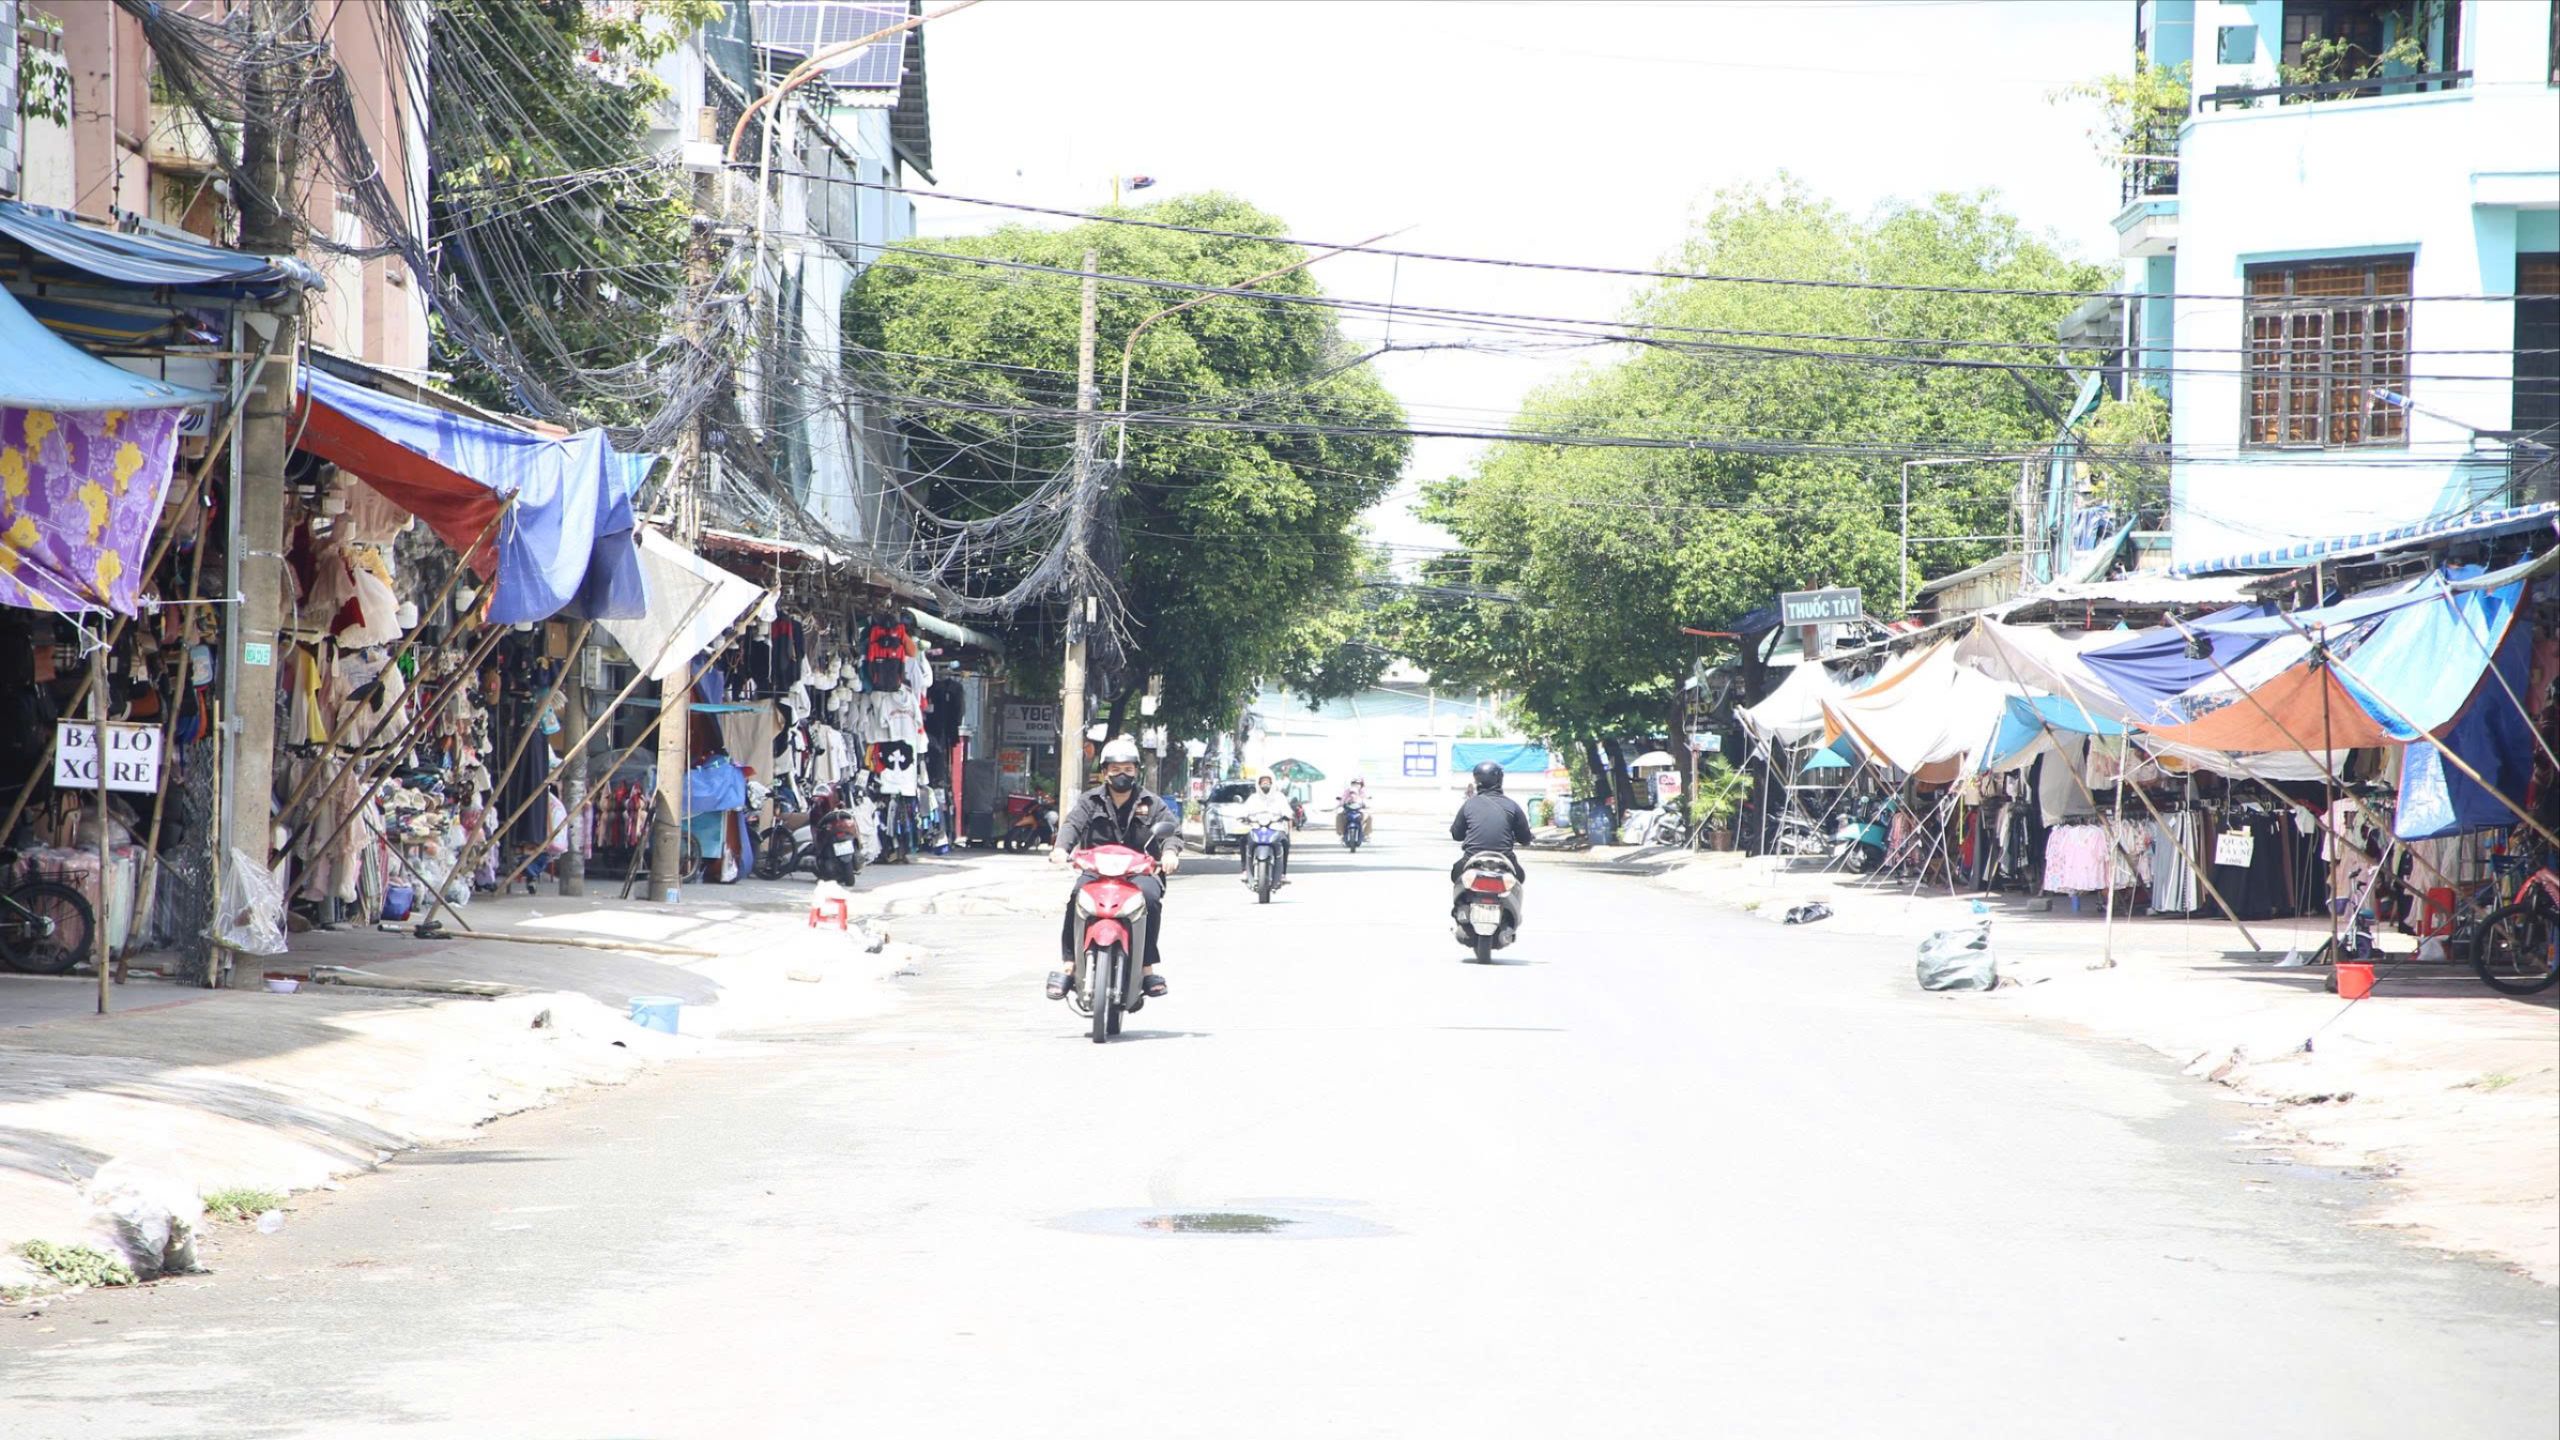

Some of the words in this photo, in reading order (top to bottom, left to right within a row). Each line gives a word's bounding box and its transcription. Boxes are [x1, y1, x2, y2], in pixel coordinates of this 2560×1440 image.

[1788, 594, 1829, 619] THUỐC
[1832, 595, 1856, 616] TÂY
[112, 727, 152, 751] LÔ
